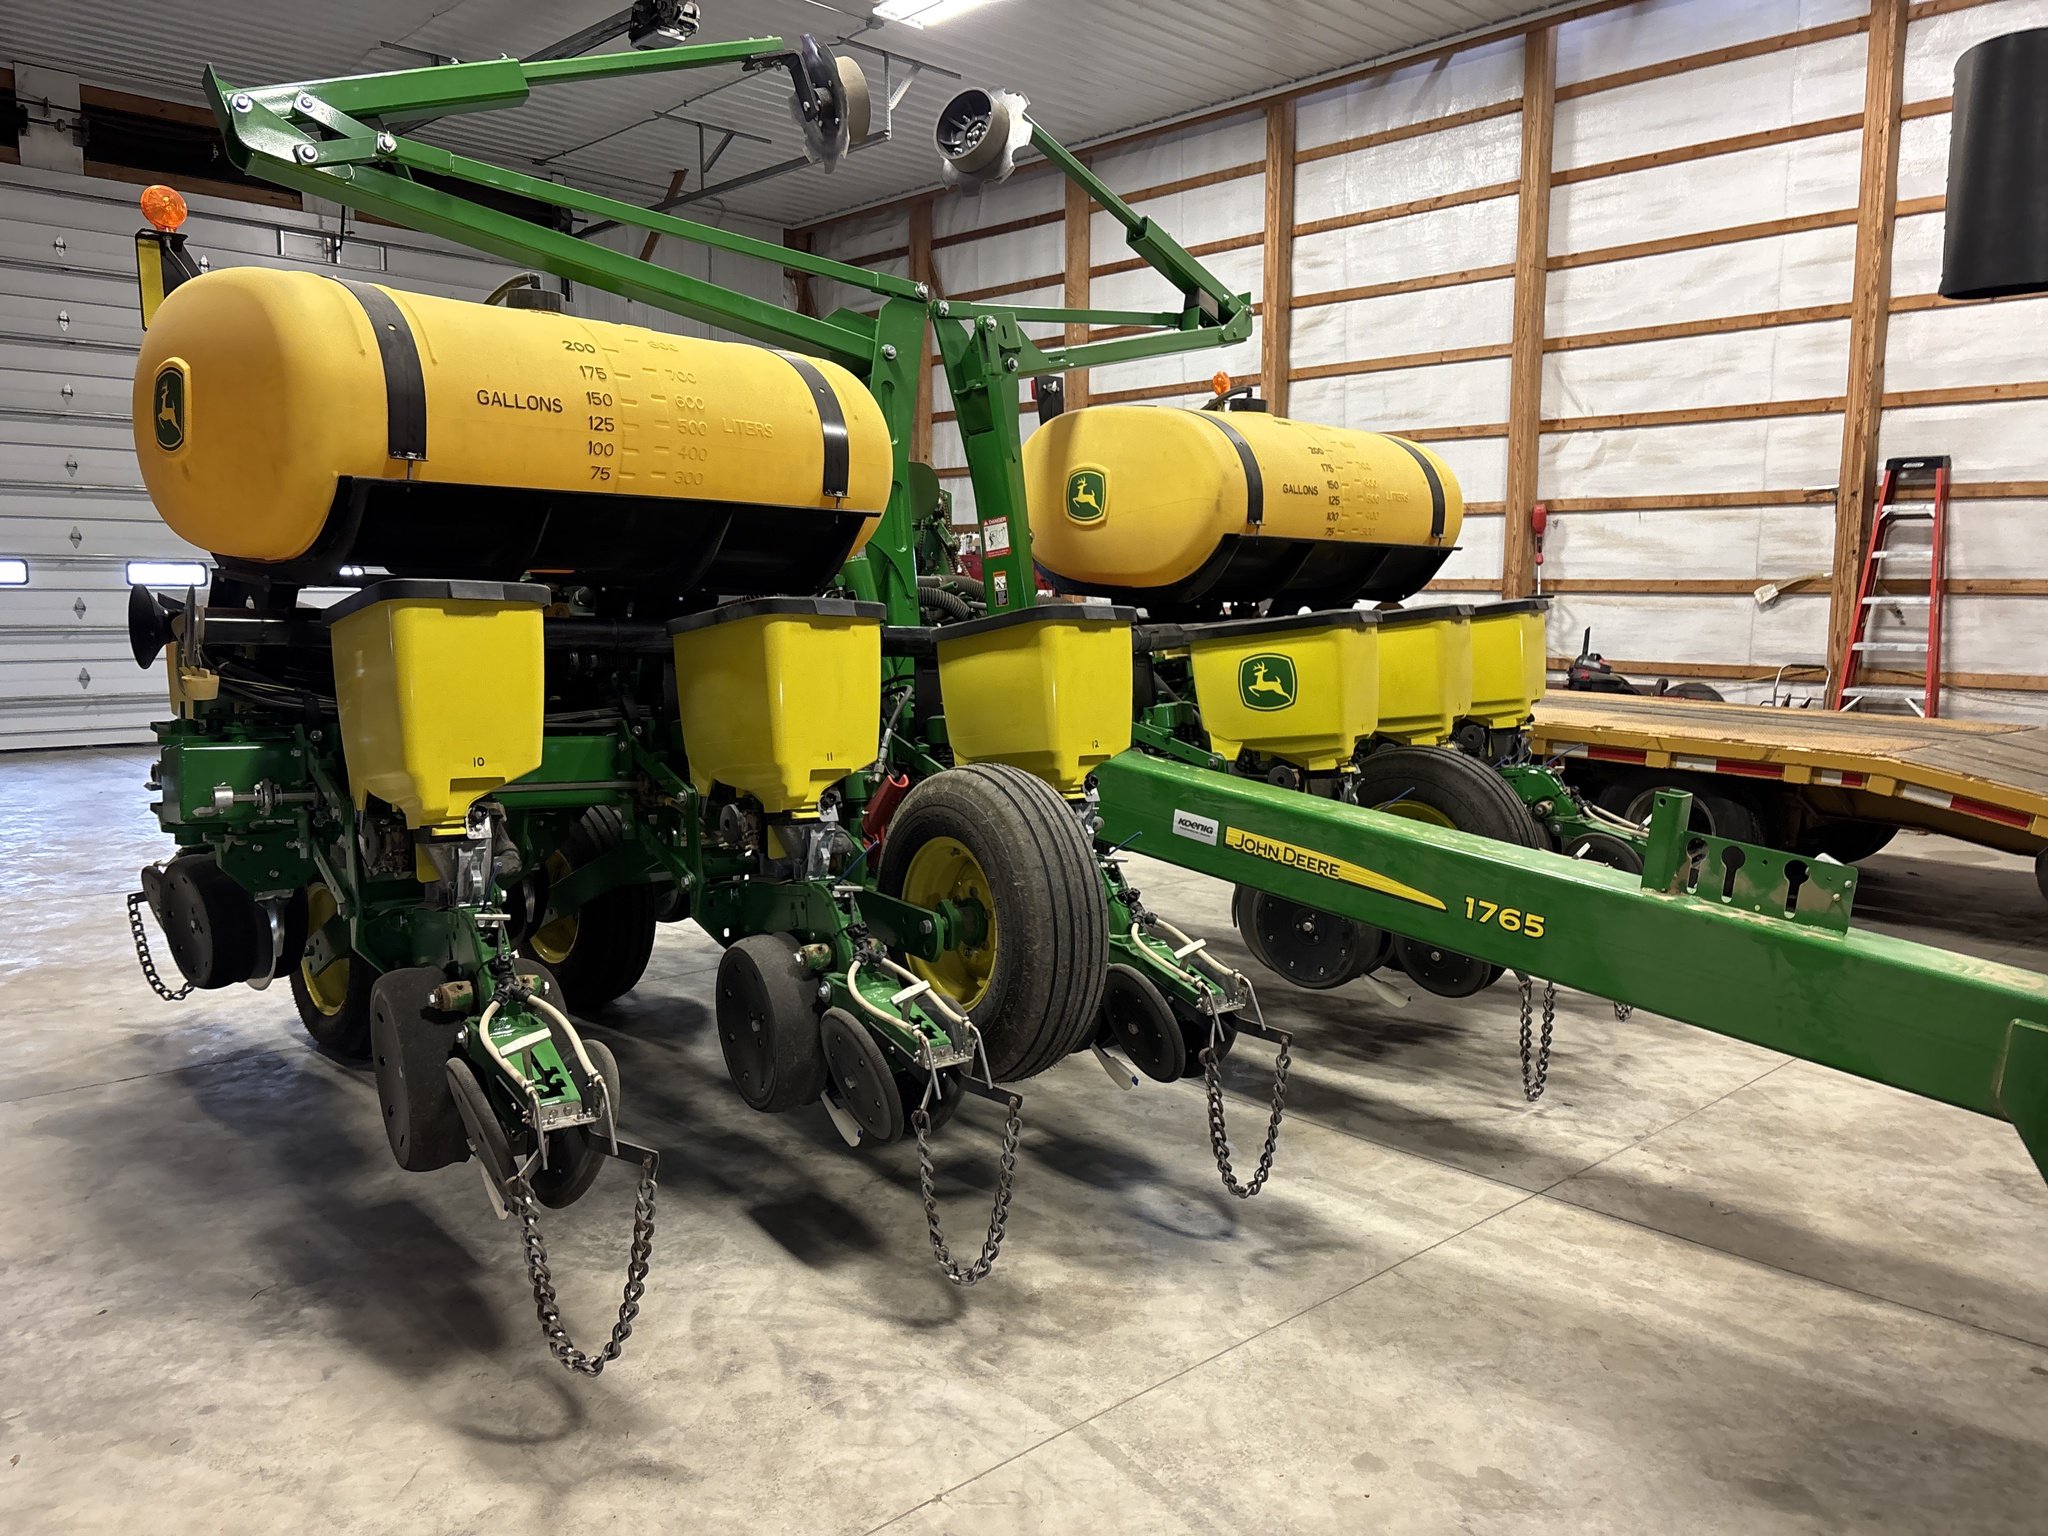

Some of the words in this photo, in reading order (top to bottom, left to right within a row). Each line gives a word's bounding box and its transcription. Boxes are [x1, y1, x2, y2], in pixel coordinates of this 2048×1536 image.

[562, 340, 596, 354] 200
[579, 365, 607, 380] 175
[664, 369, 697, 384] 700
[476, 389, 563, 414] GALLONS
[586, 391, 613, 407] 150
[674, 395, 705, 410] 600
[588, 416, 615, 432] 125
[678, 420, 708, 436] 500
[721, 417, 775, 439] LITERS
[588, 441, 614, 457] 100
[678, 445, 708, 462] 400
[590, 466, 611, 481] 75
[1321, 463, 1334, 473] 175
[674, 470, 704, 486] 300
[1327, 480, 1339, 489] 150
[1283, 483, 1319, 496] GALLONS
[1328, 495, 1340, 506] 125
[1326, 511, 1339, 521] 100
[1324, 527, 1335, 536] 75
[473, 756, 485, 768] 10
[1235, 833, 1281, 859] JOHN
[1282, 846, 1341, 878] DEERE
[1464, 895, 1547, 939] 1765
